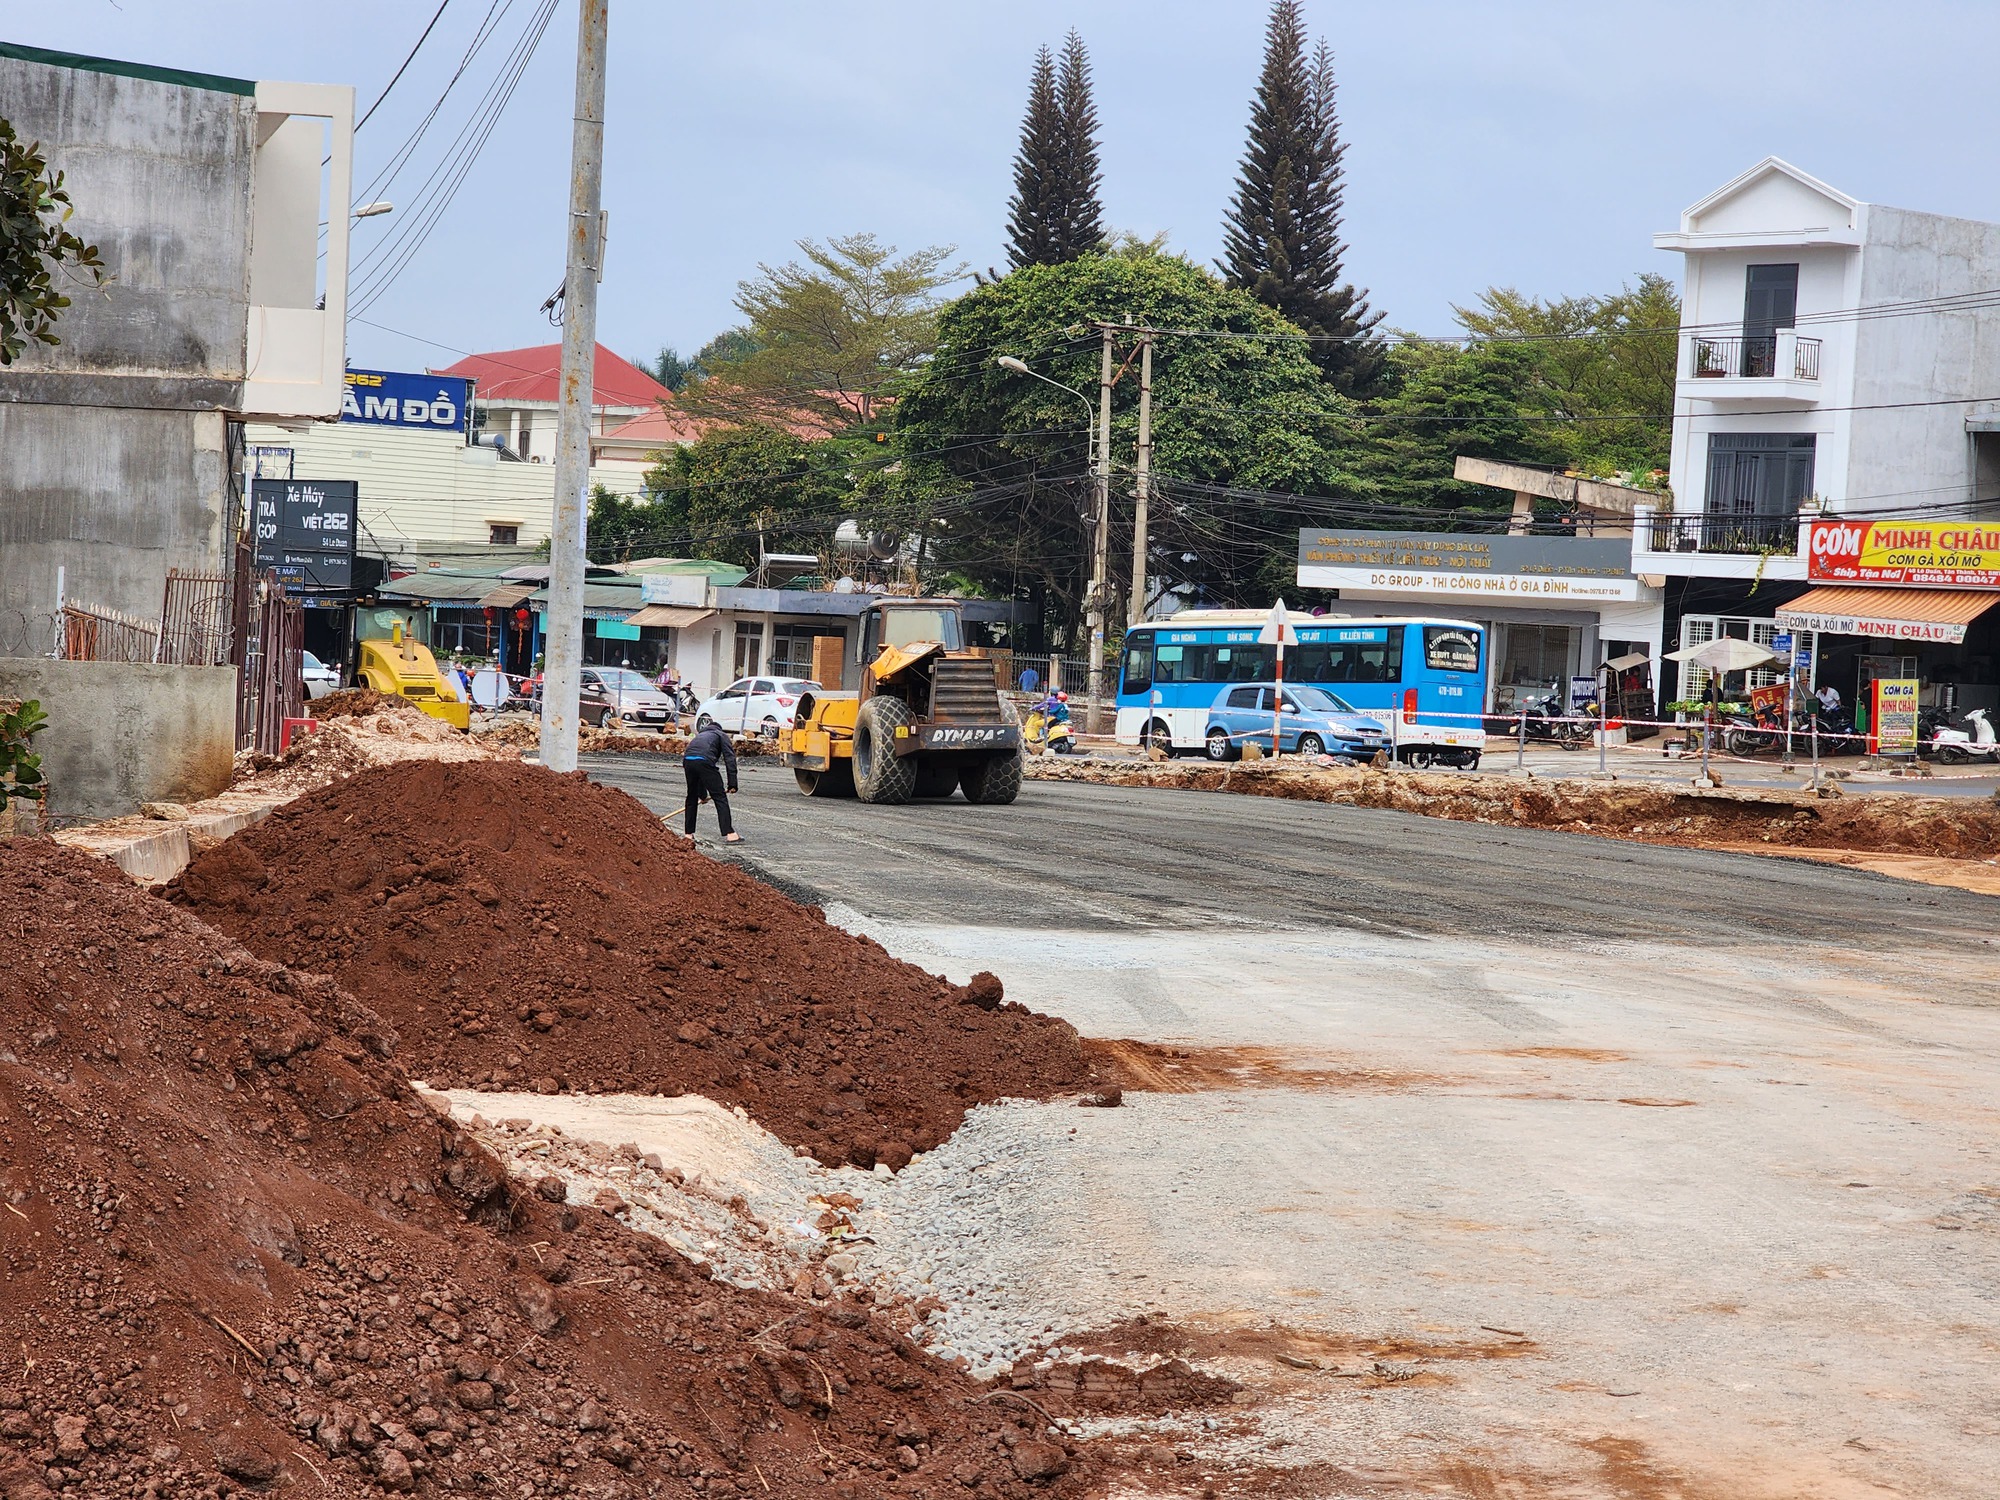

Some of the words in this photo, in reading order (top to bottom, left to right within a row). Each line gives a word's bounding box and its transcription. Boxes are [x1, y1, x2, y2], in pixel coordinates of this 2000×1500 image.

[402, 389, 456, 425] ĐỒ
[287, 486, 300, 502] Xe
[302, 486, 325, 508] Máy
[260, 496, 276, 517] TRẢ
[258, 520, 277, 539] GÓP
[302, 513, 323, 531] VIỆT
[323, 512, 348, 530] 262
[322, 537, 328, 546] 54
[1318, 535, 1340, 546] CÔNG
[1353, 535, 1365, 548] CỔ
[1812, 522, 1861, 556] CƠM
[1872, 529, 1932, 550] MINH
[1938, 527, 2000, 551] CHÂU
[1306, 549, 1323, 561] VĂN
[1325, 549, 1357, 562] PHÒNG
[1359, 549, 1381, 564] THIẾT
[1383, 549, 1396, 565] KẾ
[1397, 550, 1416, 565] KIẾN
[1419, 553, 1442, 567] TRÚC
[1449, 554, 1467, 571] NỘI
[1470, 553, 1492, 569] THẤT
[1888, 554, 1914, 566] CƠM
[1918, 552, 1935, 566] GÀ
[1938, 551, 1958, 567] XỐI
[1961, 554, 1983, 567] MỠ
[282, 567, 298, 575] MÁY
[1833, 567, 1857, 579] Ship
[1860, 568, 1880, 582] Tận
[1881, 569, 1901, 579] Nơi
[1912, 574, 1952, 582] 08484
[1956, 575, 1997, 584] 00047
[1371, 574, 1386, 585] DC
[1388, 575, 1423, 586] GROUP
[1432, 577, 1447, 588] THI
[1450, 576, 1481, 589] CÔNG
[1484, 576, 1505, 590] NHÀ
[1509, 576, 1518, 591] Ở
[1520, 581, 1540, 593] GIA
[1543, 578, 1568, 593] ĐÌNH
[1789, 615, 1808, 629] CƠM
[1810, 615, 1821, 629] GÀ
[1823, 615, 1838, 631] XỐI
[1841, 619, 1854, 632] MỠ
[1857, 621, 1897, 636] MINH
[1900, 623, 1944, 639] CHÂU
[1239, 632, 1254, 642] SONG
[1883, 684, 1900, 695] CƠM
[1881, 700, 1897, 712] MINH
